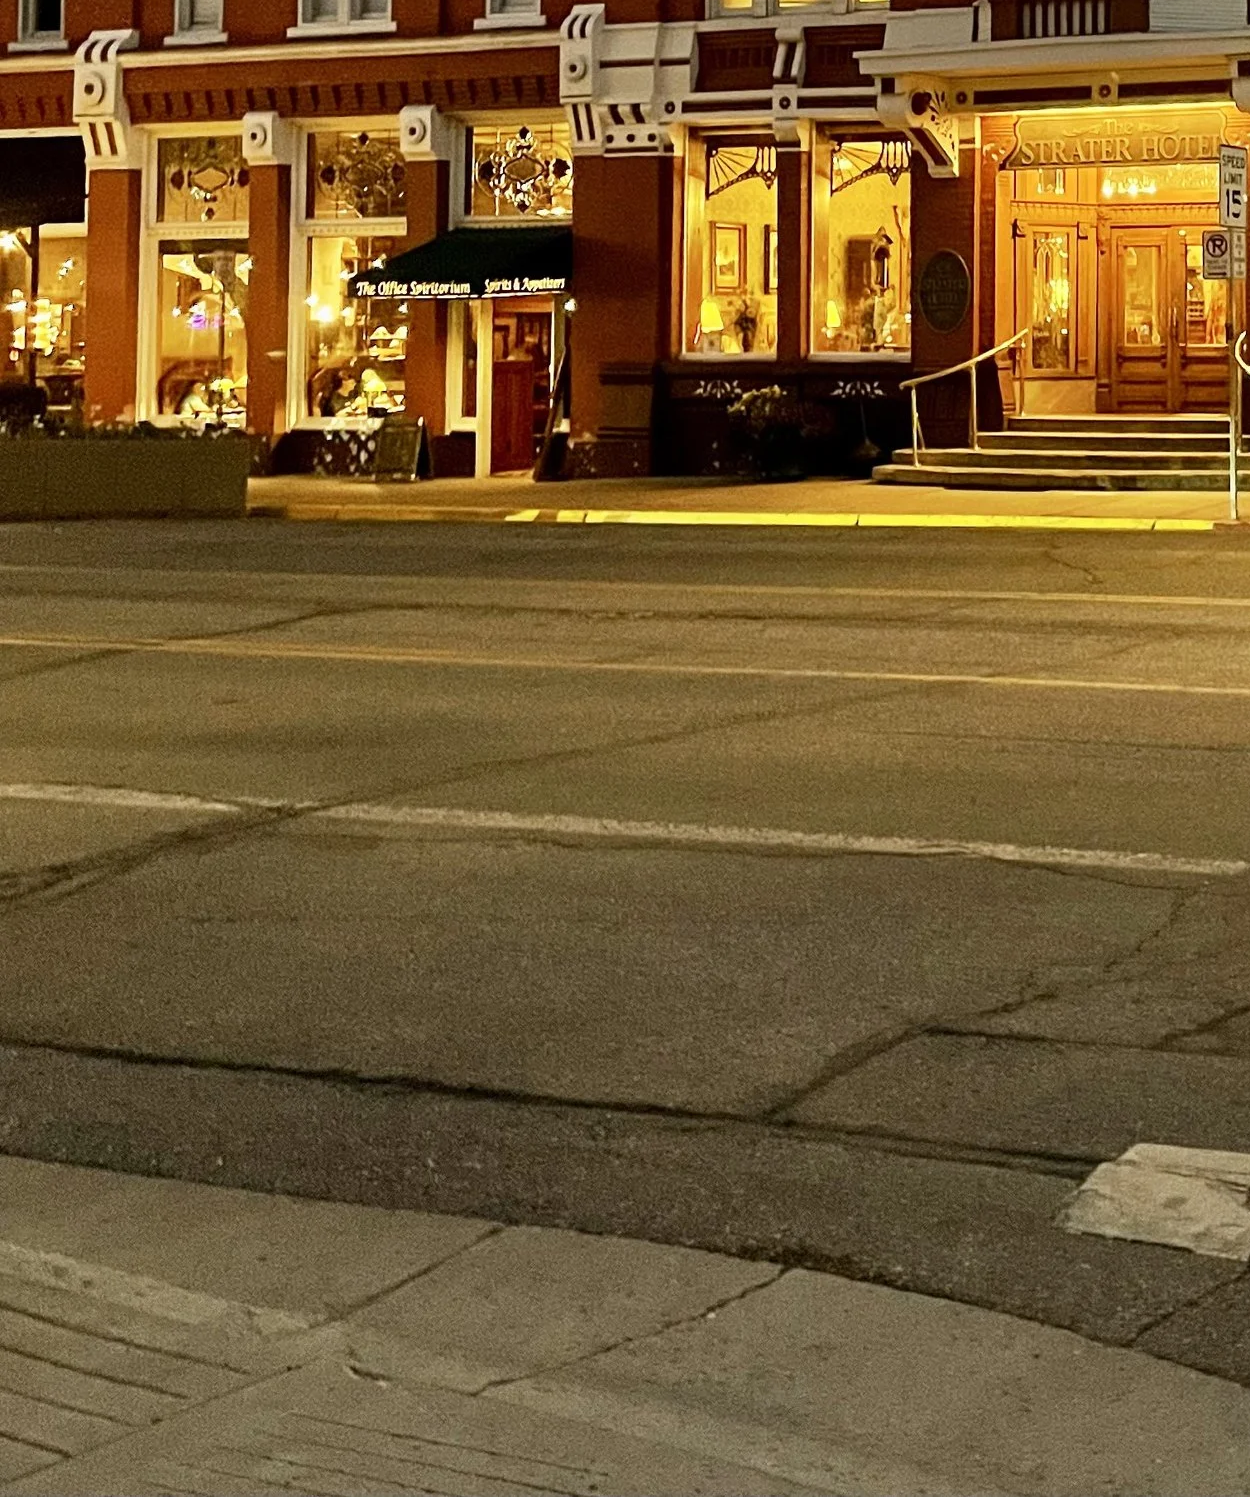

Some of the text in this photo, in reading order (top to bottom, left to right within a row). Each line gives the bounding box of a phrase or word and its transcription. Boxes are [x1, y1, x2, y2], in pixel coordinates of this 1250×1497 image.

[1102, 119, 1133, 135] The
[1021, 137, 1132, 165] STRATER
[1222, 154, 1245, 169] SPEED
[1224, 173, 1243, 185] LIMIT
[1226, 189, 1242, 219] 15
[356, 279, 471, 296] The Office Spiritorium
[484, 277, 512, 294] Spirits
